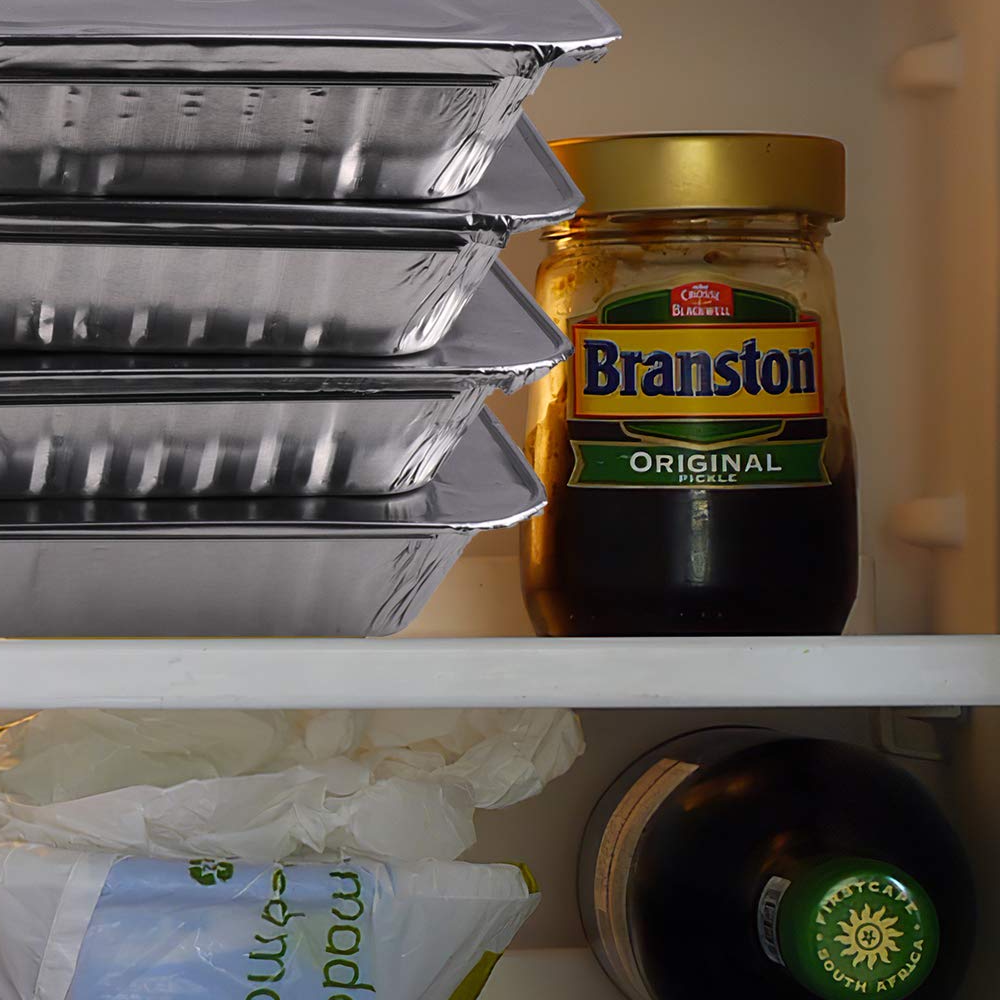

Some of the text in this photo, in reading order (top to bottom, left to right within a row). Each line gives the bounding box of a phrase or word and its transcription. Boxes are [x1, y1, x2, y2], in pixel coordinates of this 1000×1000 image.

[583, 338, 816, 397] Branston
[629, 451, 782, 473] ORIGINAL
[679, 474, 737, 483] PICKLE
[323, 871, 376, 1000] mad
[818, 948, 867, 993] SOUTH
